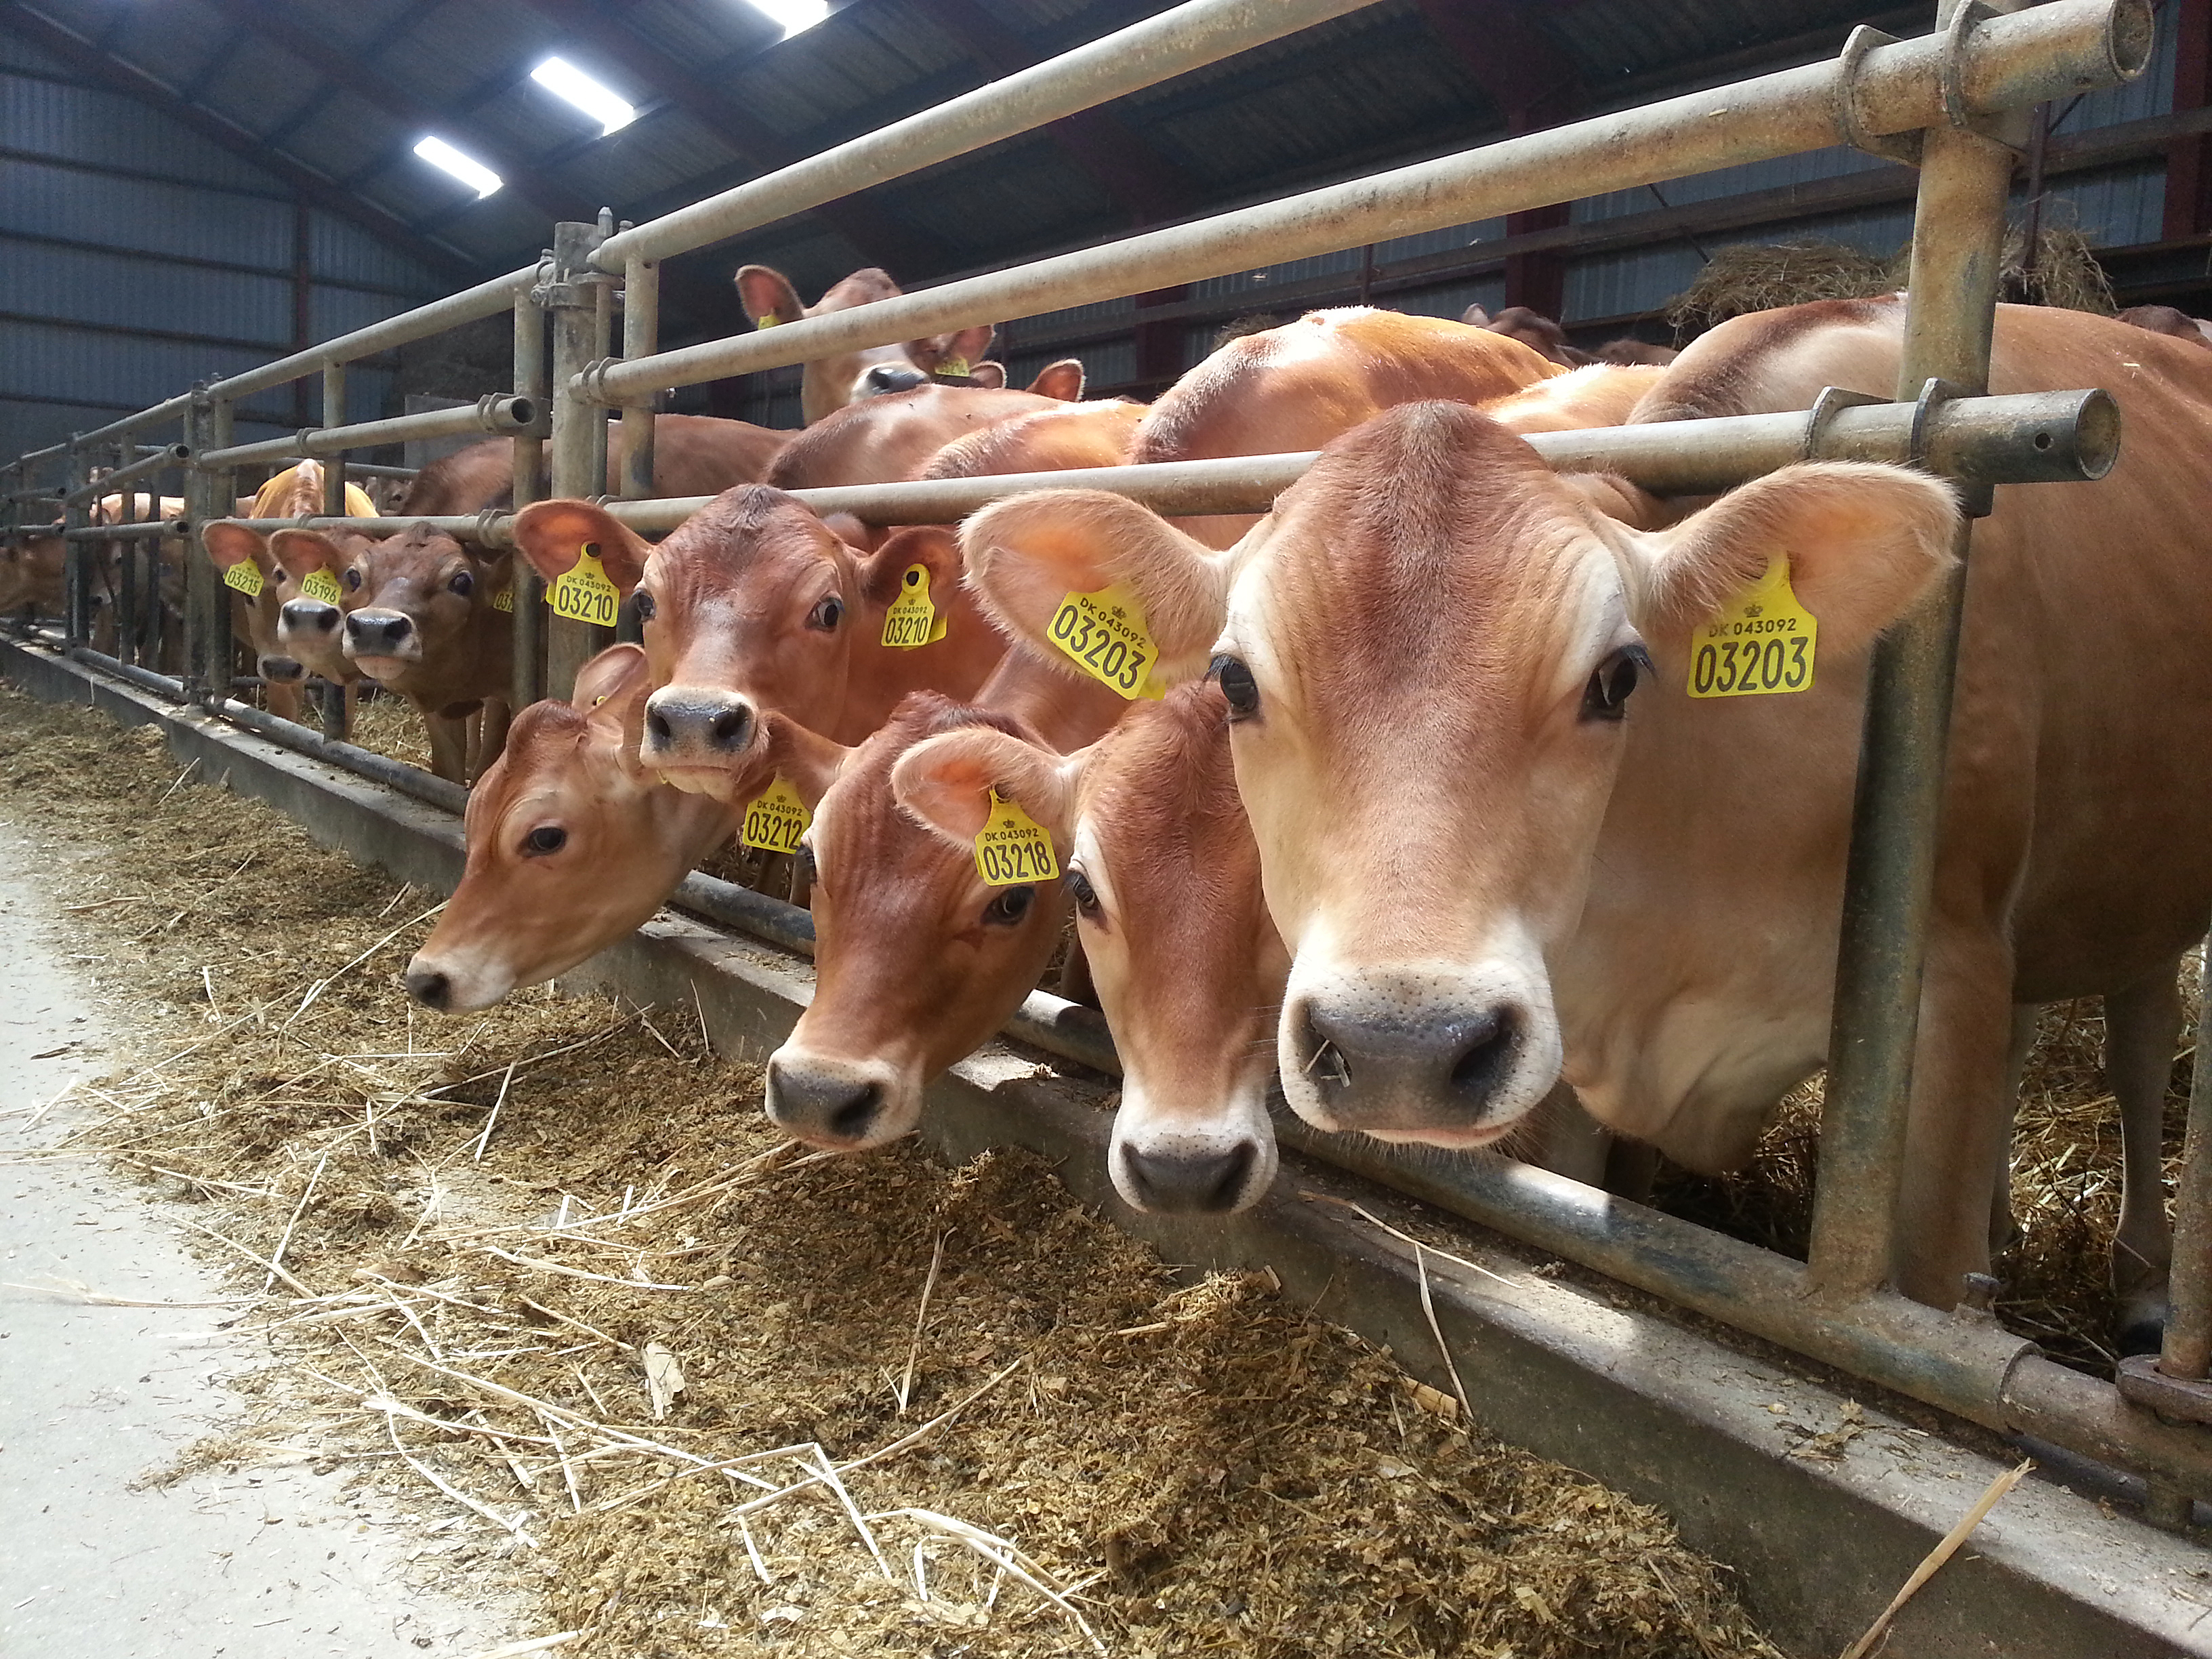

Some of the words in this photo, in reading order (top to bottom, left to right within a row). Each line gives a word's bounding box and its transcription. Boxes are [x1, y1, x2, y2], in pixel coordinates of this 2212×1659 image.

[228, 571, 260, 593] 03215
[304, 579, 337, 602] 03196
[567, 575, 577, 584] DK
[579, 579, 611, 592] 043092
[558, 585, 613, 621] 03210
[903, 606, 928, 615] 043092
[885, 616, 928, 644] 03210
[1080, 597, 1097, 615] DK
[1099, 611, 1147, 649] 043092
[1708, 623, 1729, 638] DK
[1734, 617, 1797, 636] 043092
[1054, 605, 1146, 689] 03203
[1695, 636, 1809, 694] 03203
[757, 800, 768, 810] DK
[769, 803, 802, 817] 043092
[747, 811, 802, 850] 03212
[985, 832, 998, 842] DK
[1000, 828, 1039, 840] 043092
[983, 840, 1051, 880] 03218
